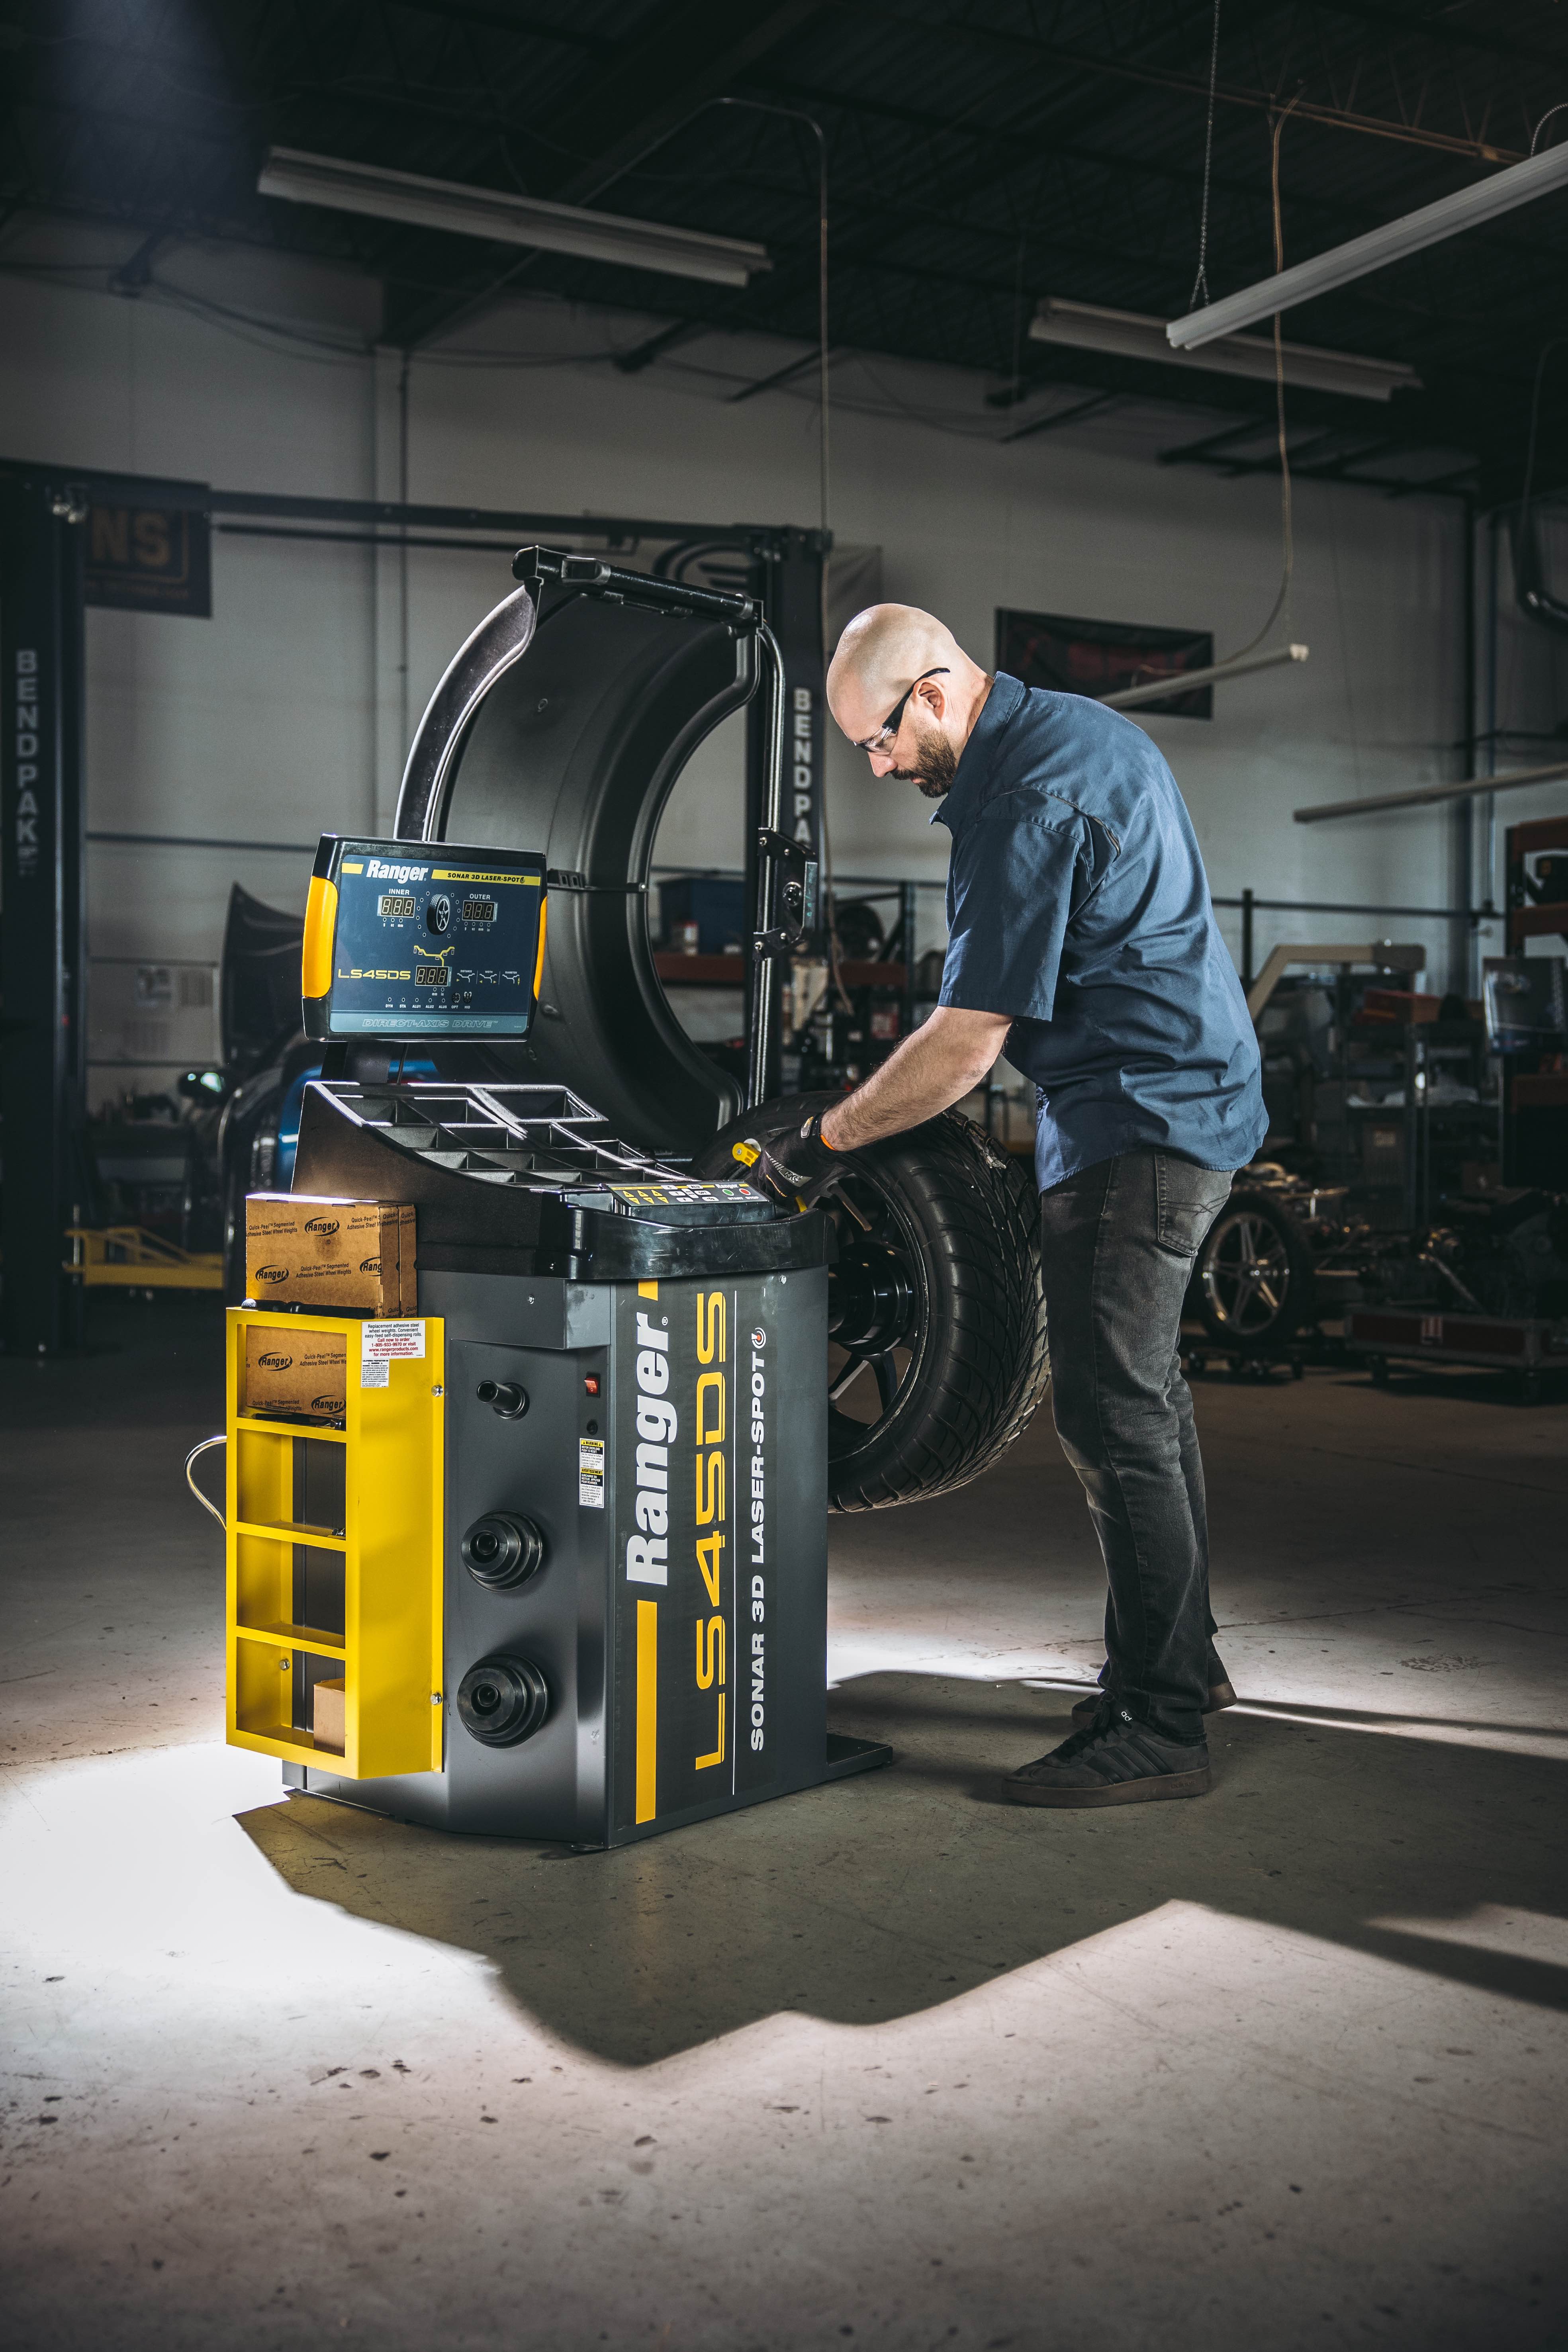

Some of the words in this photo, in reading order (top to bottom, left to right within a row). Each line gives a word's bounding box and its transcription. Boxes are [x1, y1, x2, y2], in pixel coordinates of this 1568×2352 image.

[366, 859, 429, 884] Ranger
[338, 969, 411, 980] LS45DS
[362, 1019, 449, 1028] DIRECT-AXIS
[307, 1222, 335, 1233] Ranger
[258, 1270, 285, 1281] Ranger
[261, 1356, 288, 1368] Ranger
[314, 1398, 343, 1411] Ranger
[751, 1351, 765, 1563] LASER-SPOT
[695, 1291, 726, 1771] LS45DS
[751, 1575, 764, 1622] 3D
[751, 1633, 764, 1751] SONAR
